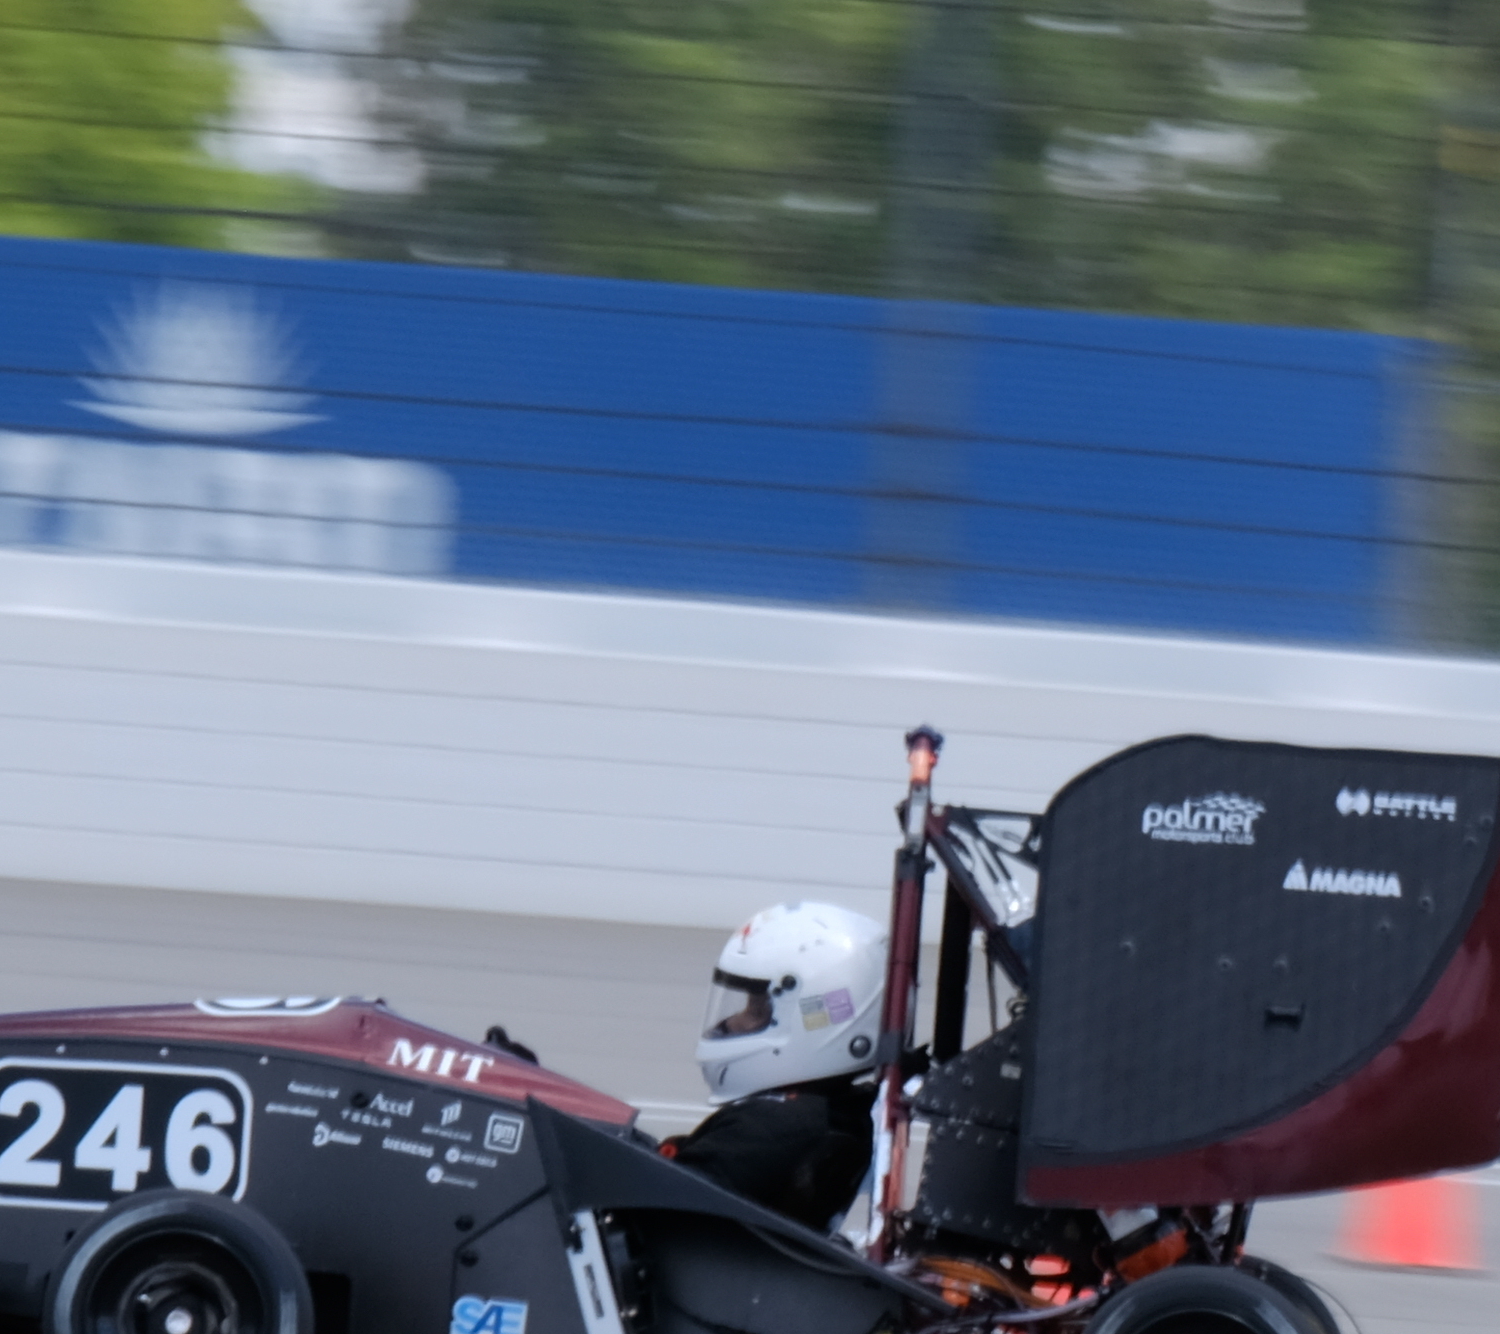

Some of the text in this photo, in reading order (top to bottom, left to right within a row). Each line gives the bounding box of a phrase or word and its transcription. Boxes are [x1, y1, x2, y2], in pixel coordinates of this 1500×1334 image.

[1142, 797, 1258, 835] palmer
[1310, 868, 1402, 898] MAGNA
[386, 1038, 495, 1084] MIT
[341, 1109, 393, 1128] TESLA
[369, 1091, 415, 1118] Accel
[382, 1137, 435, 1159] SIEMENS
